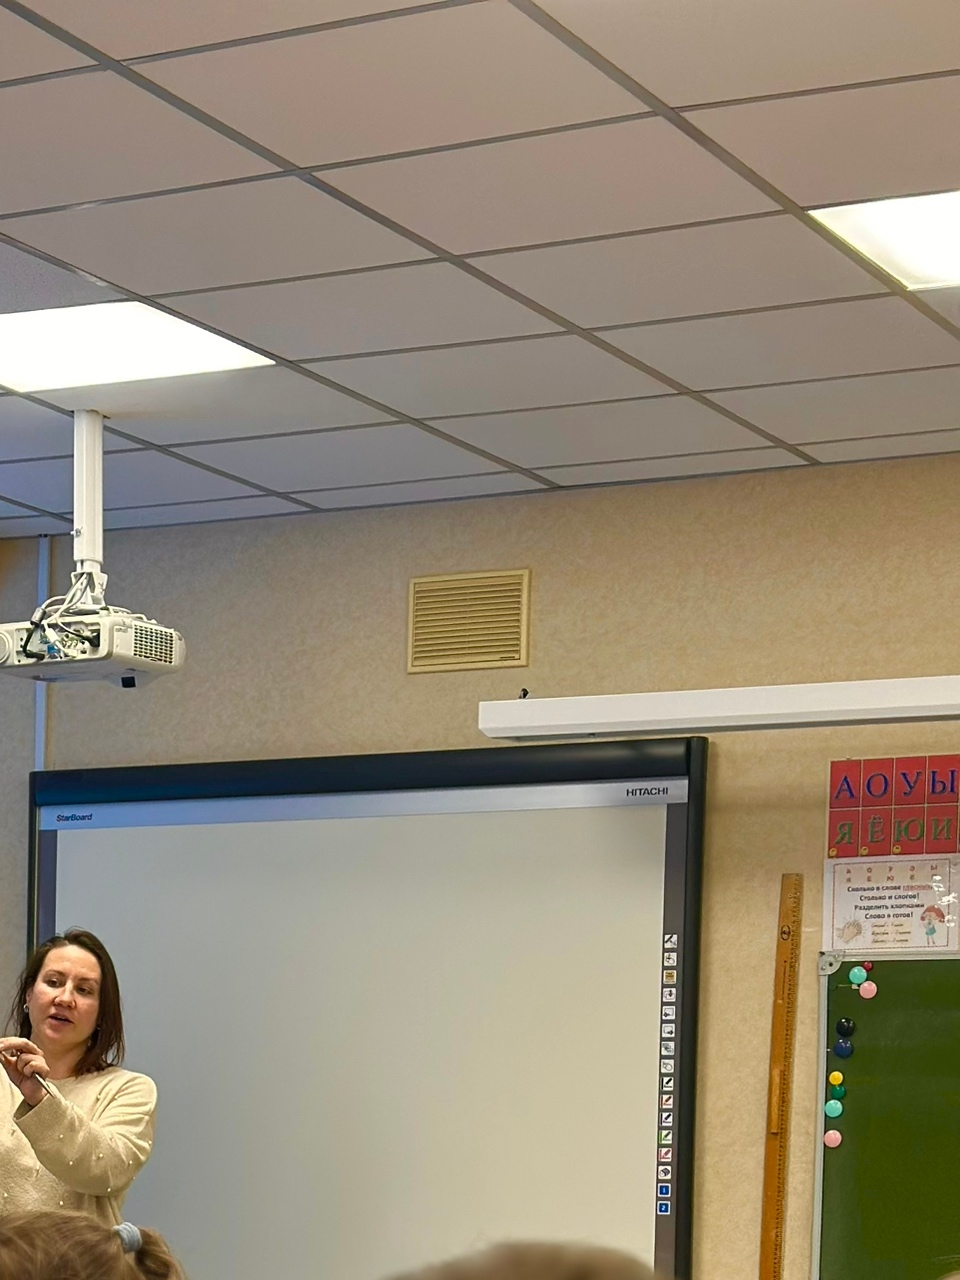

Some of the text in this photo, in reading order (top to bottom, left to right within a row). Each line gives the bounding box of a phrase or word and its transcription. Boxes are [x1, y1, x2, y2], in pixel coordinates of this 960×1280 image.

[834, 769, 958, 800] А О У Ы
[626, 787, 668, 796] HITACHI
[56, 813, 93, 822] StarBoard
[834, 815, 953, 845] Я Ё Ю И
[894, 892, 920, 900] слогов!
